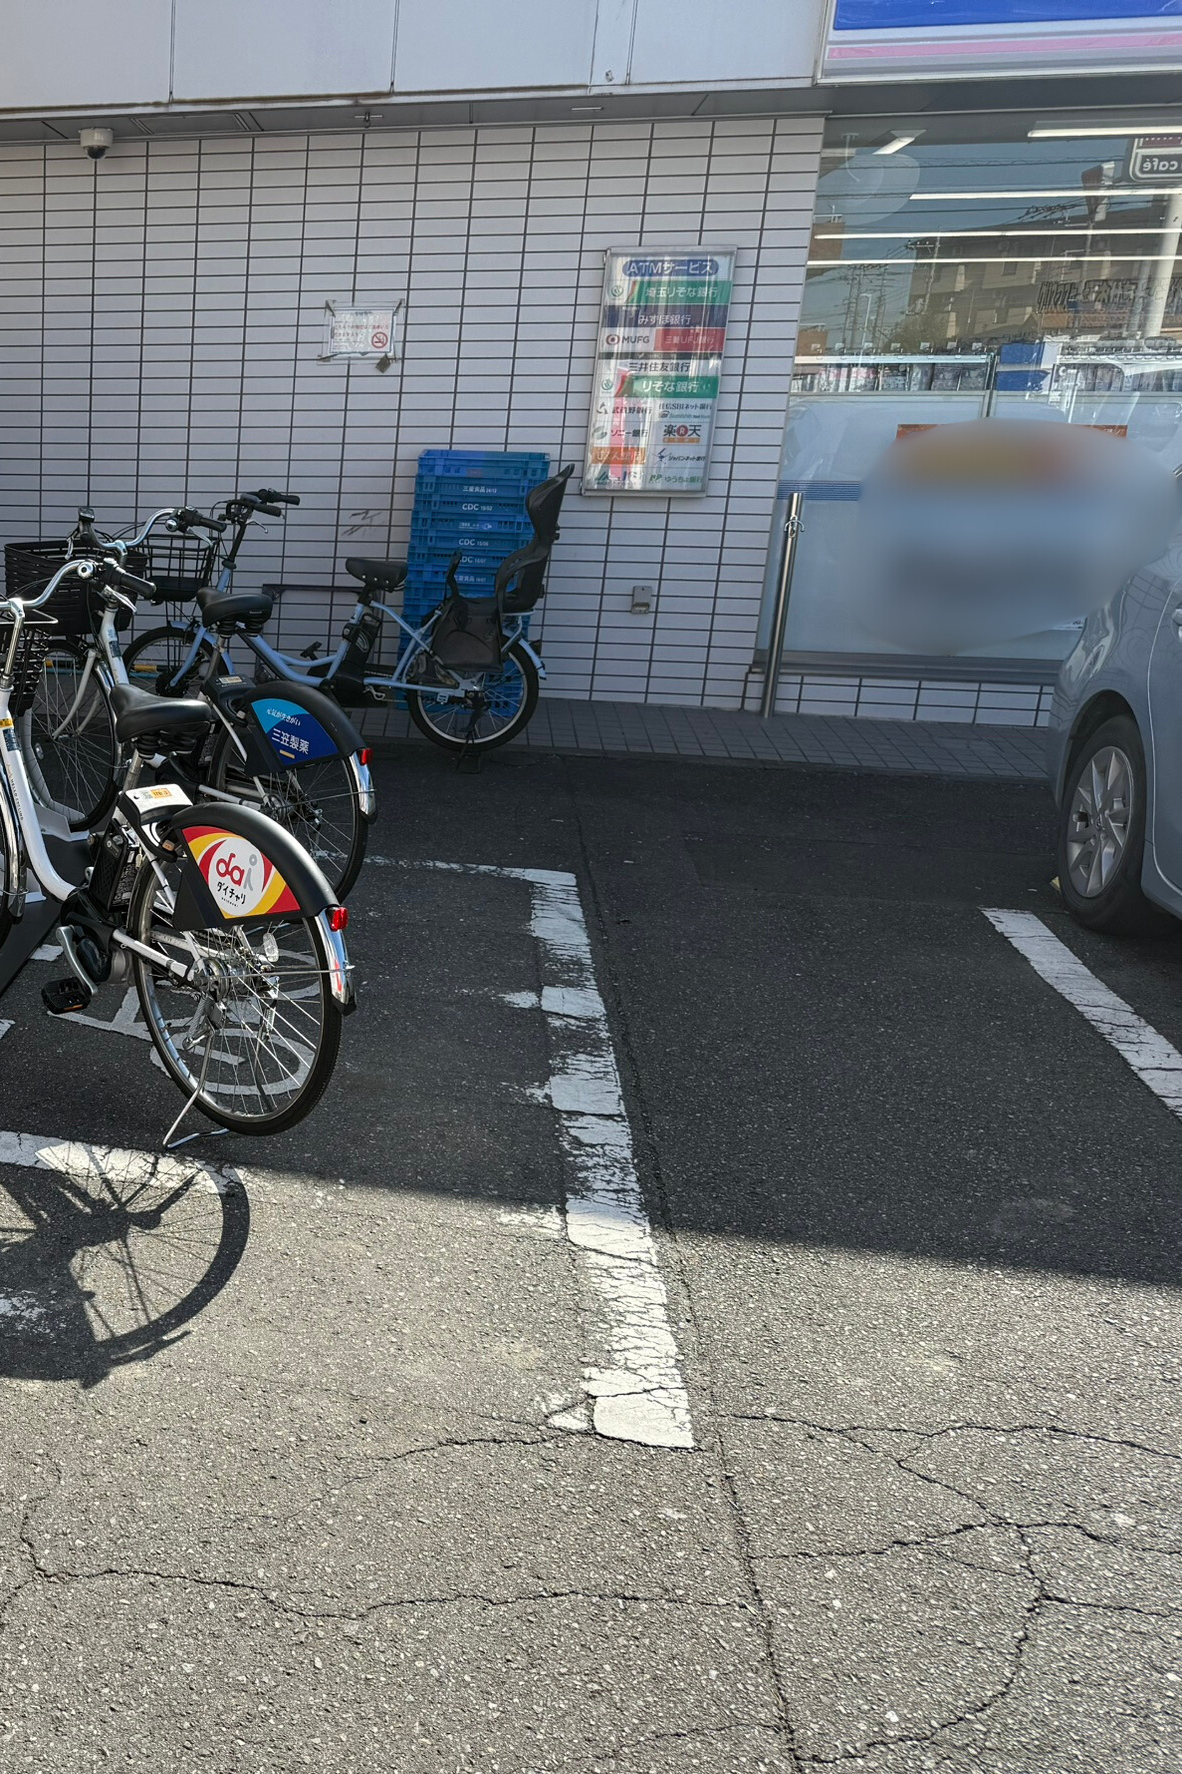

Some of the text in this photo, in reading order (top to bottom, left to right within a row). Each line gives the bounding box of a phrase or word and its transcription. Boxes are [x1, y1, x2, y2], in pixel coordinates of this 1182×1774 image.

[627, 261, 714, 274] ATMサービス
[645, 285, 718, 297] 埼玉りそな銀行
[638, 314, 692, 325] みずほ銀行
[621, 336, 650, 344] MUFG
[628, 362, 691, 373] 三井住友銀行
[642, 380, 699, 393] りそな銀行
[462, 503, 479, 511] CDC
[458, 538, 475, 546] CDC
[271, 728, 310, 755] 三笠製薬
[216, 852, 258, 891] dai
[217, 881, 246, 905] ダイチャリ
